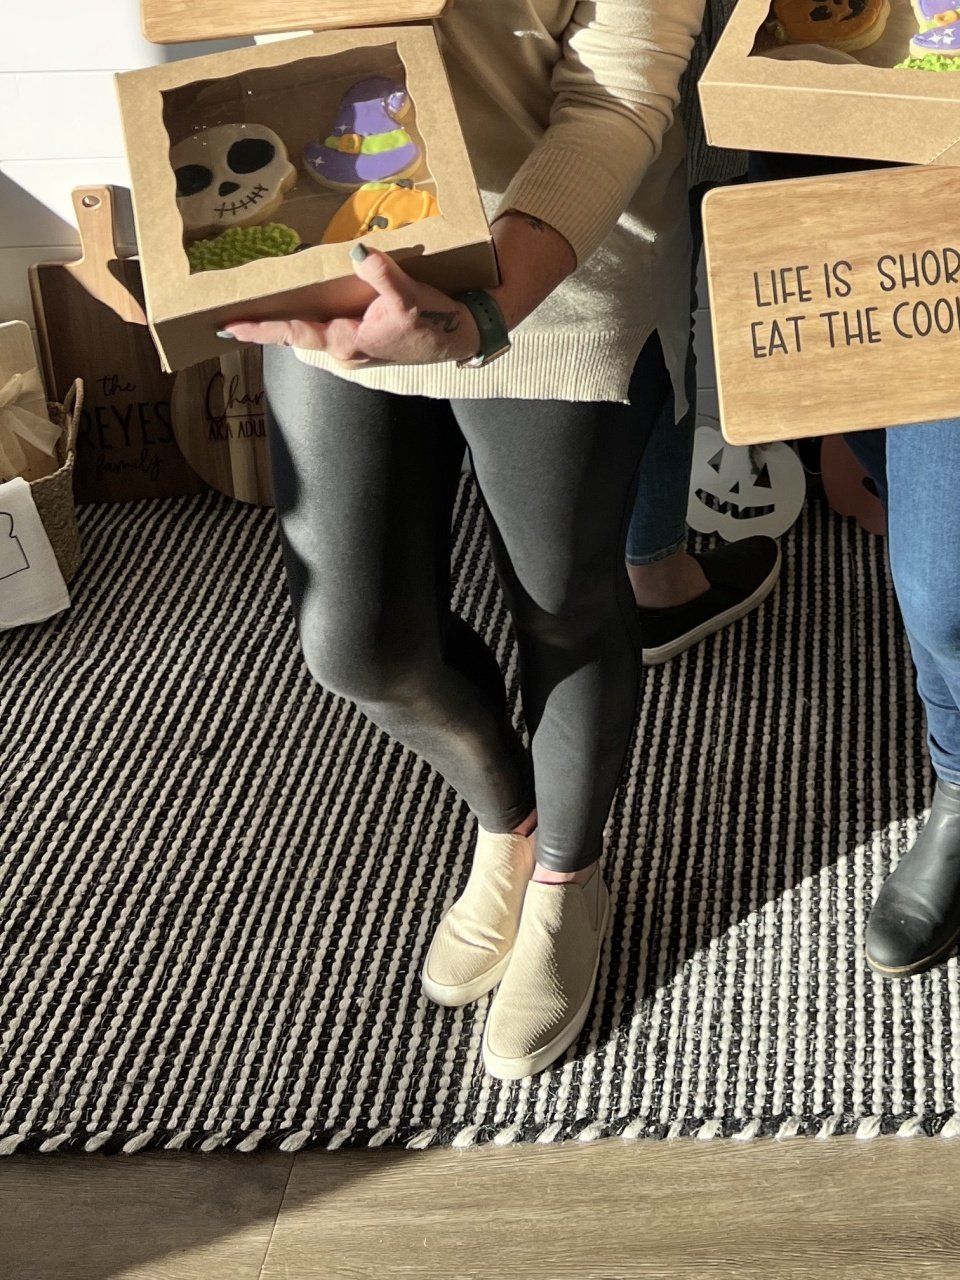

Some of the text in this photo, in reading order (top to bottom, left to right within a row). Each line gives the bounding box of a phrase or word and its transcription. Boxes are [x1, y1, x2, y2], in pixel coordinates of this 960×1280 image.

[753, 265, 812, 308] LIFE
[823, 260, 853, 299] IS
[750, 315, 807, 359] EAT
[819, 306, 883, 349] THE
[97, 375, 136, 397] the
